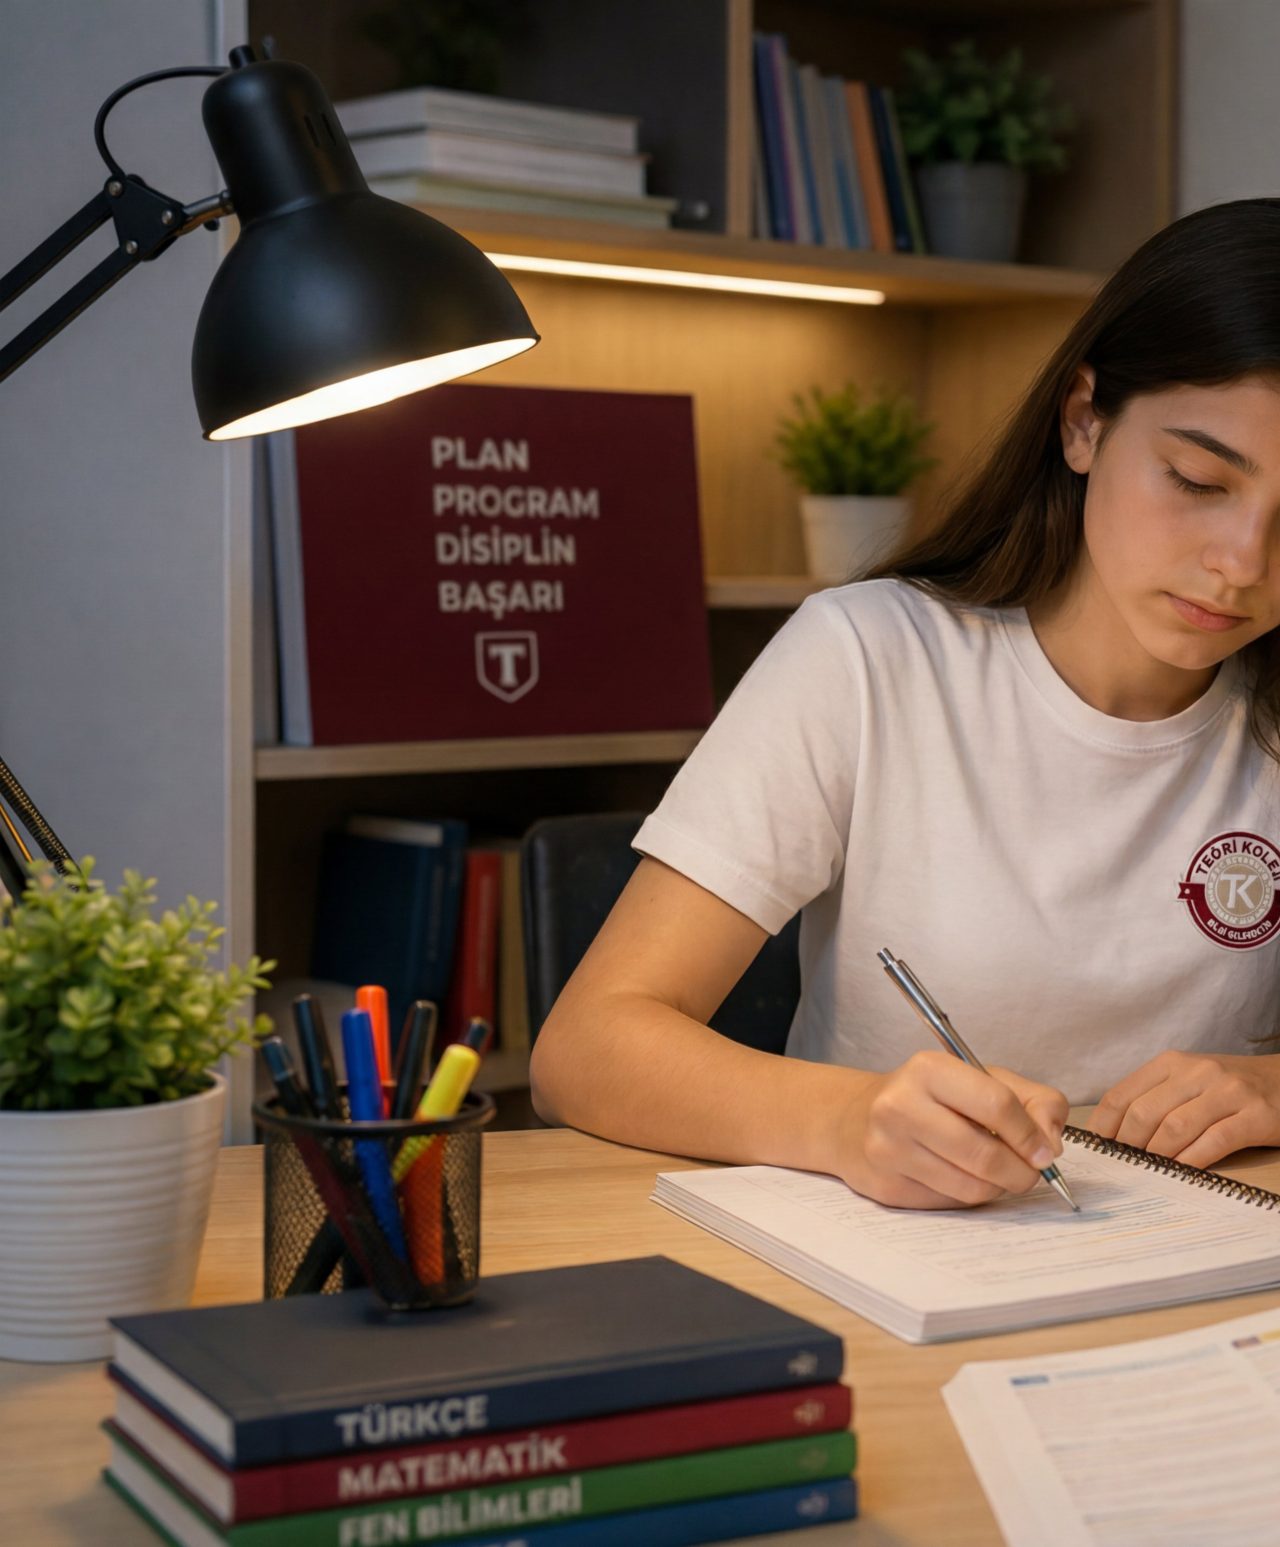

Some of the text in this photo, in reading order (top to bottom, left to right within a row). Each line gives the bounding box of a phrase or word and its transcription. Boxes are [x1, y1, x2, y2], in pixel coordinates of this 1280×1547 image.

[431, 436, 530, 471] PLAN
[433, 484, 600, 519] PROGRAM
[435, 525, 577, 566] DİSİPLİN
[438, 580, 564, 621] BAŞARI
[488, 643, 526, 688] T
[335, 1394, 489, 1447] TÜRKÇE
[337, 1431, 568, 1500] MATEMATİK
[338, 1474, 583, 1547] FEN BİLİMLERİ
